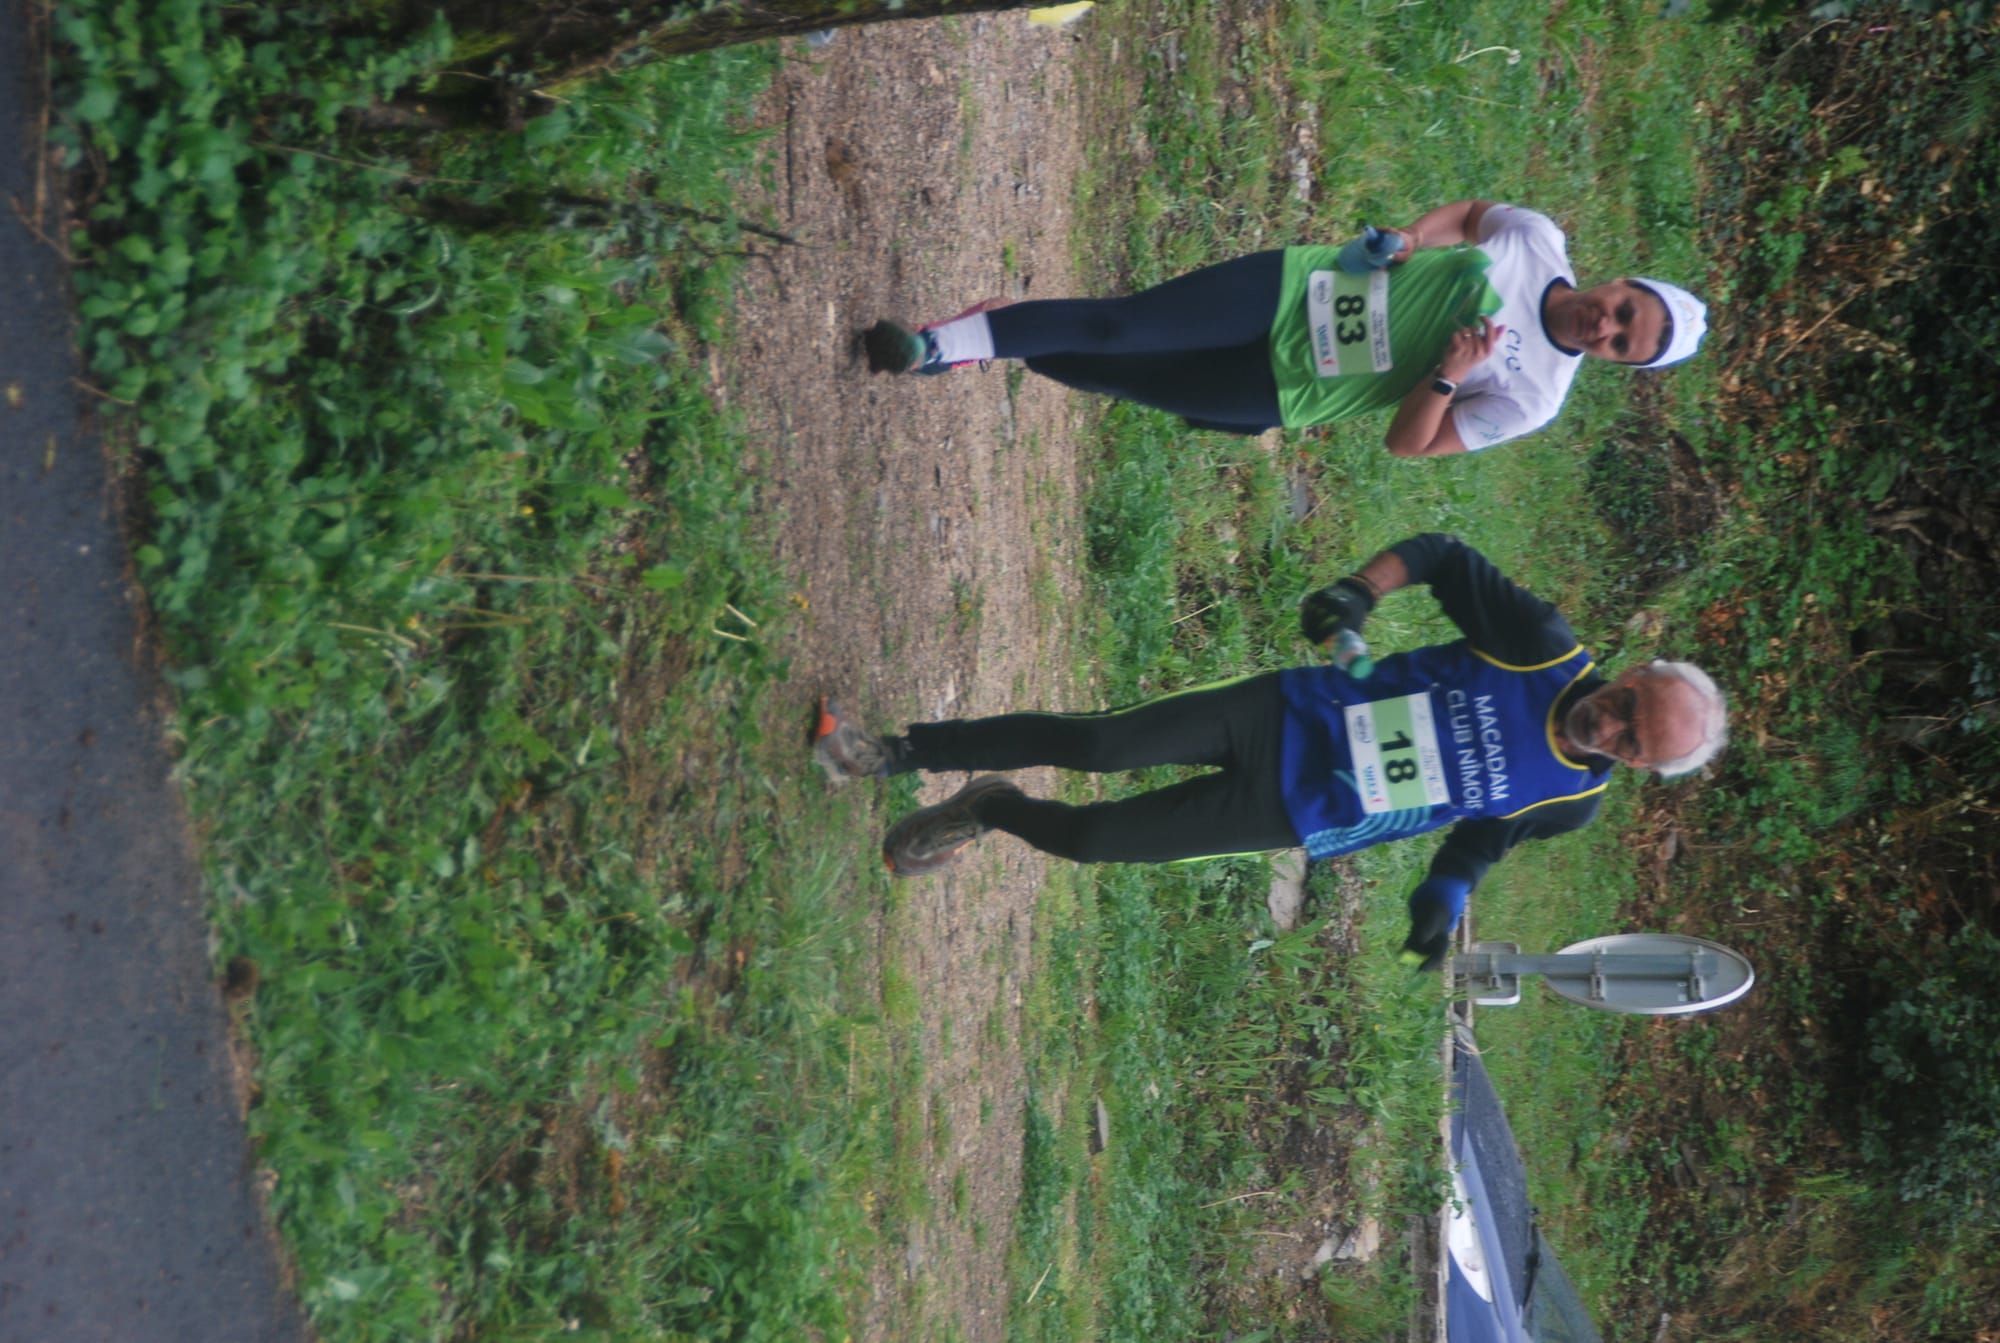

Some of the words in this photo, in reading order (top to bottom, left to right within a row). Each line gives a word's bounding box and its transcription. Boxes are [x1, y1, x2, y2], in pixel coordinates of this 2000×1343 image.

[1335, 295, 1367, 345] 83
[1446, 689, 1474, 744] CLUB
[1379, 730, 1419, 784] 18
[1473, 695, 1511, 801] MACADAM
